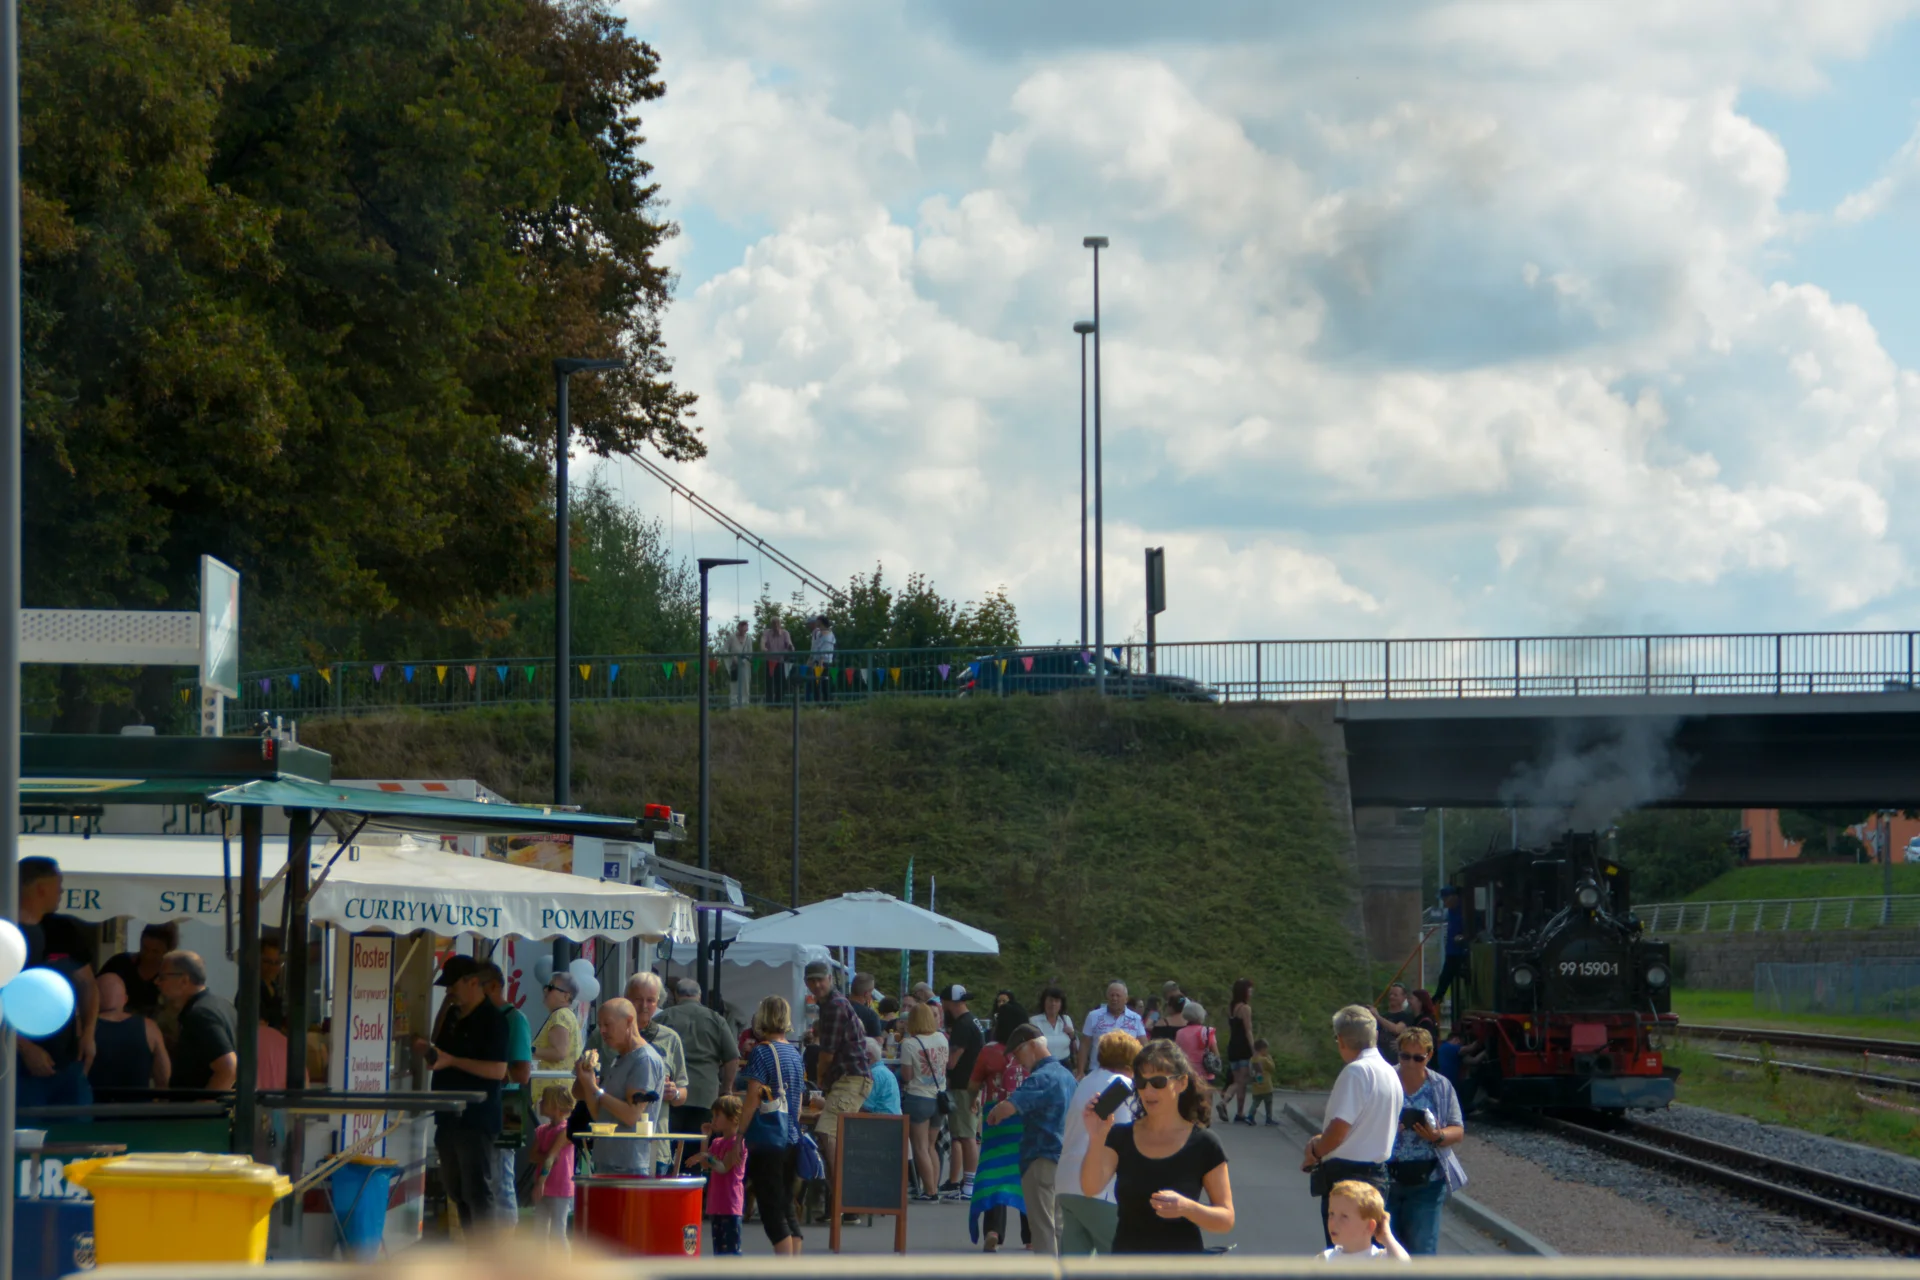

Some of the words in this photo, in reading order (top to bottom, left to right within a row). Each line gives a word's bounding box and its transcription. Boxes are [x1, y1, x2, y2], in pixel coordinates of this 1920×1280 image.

[344, 897, 503, 928] CURRYWURST
[542, 908, 635, 931] POMMES
[354, 943, 390, 969] Roster
[353, 1013, 384, 1041] Steak
